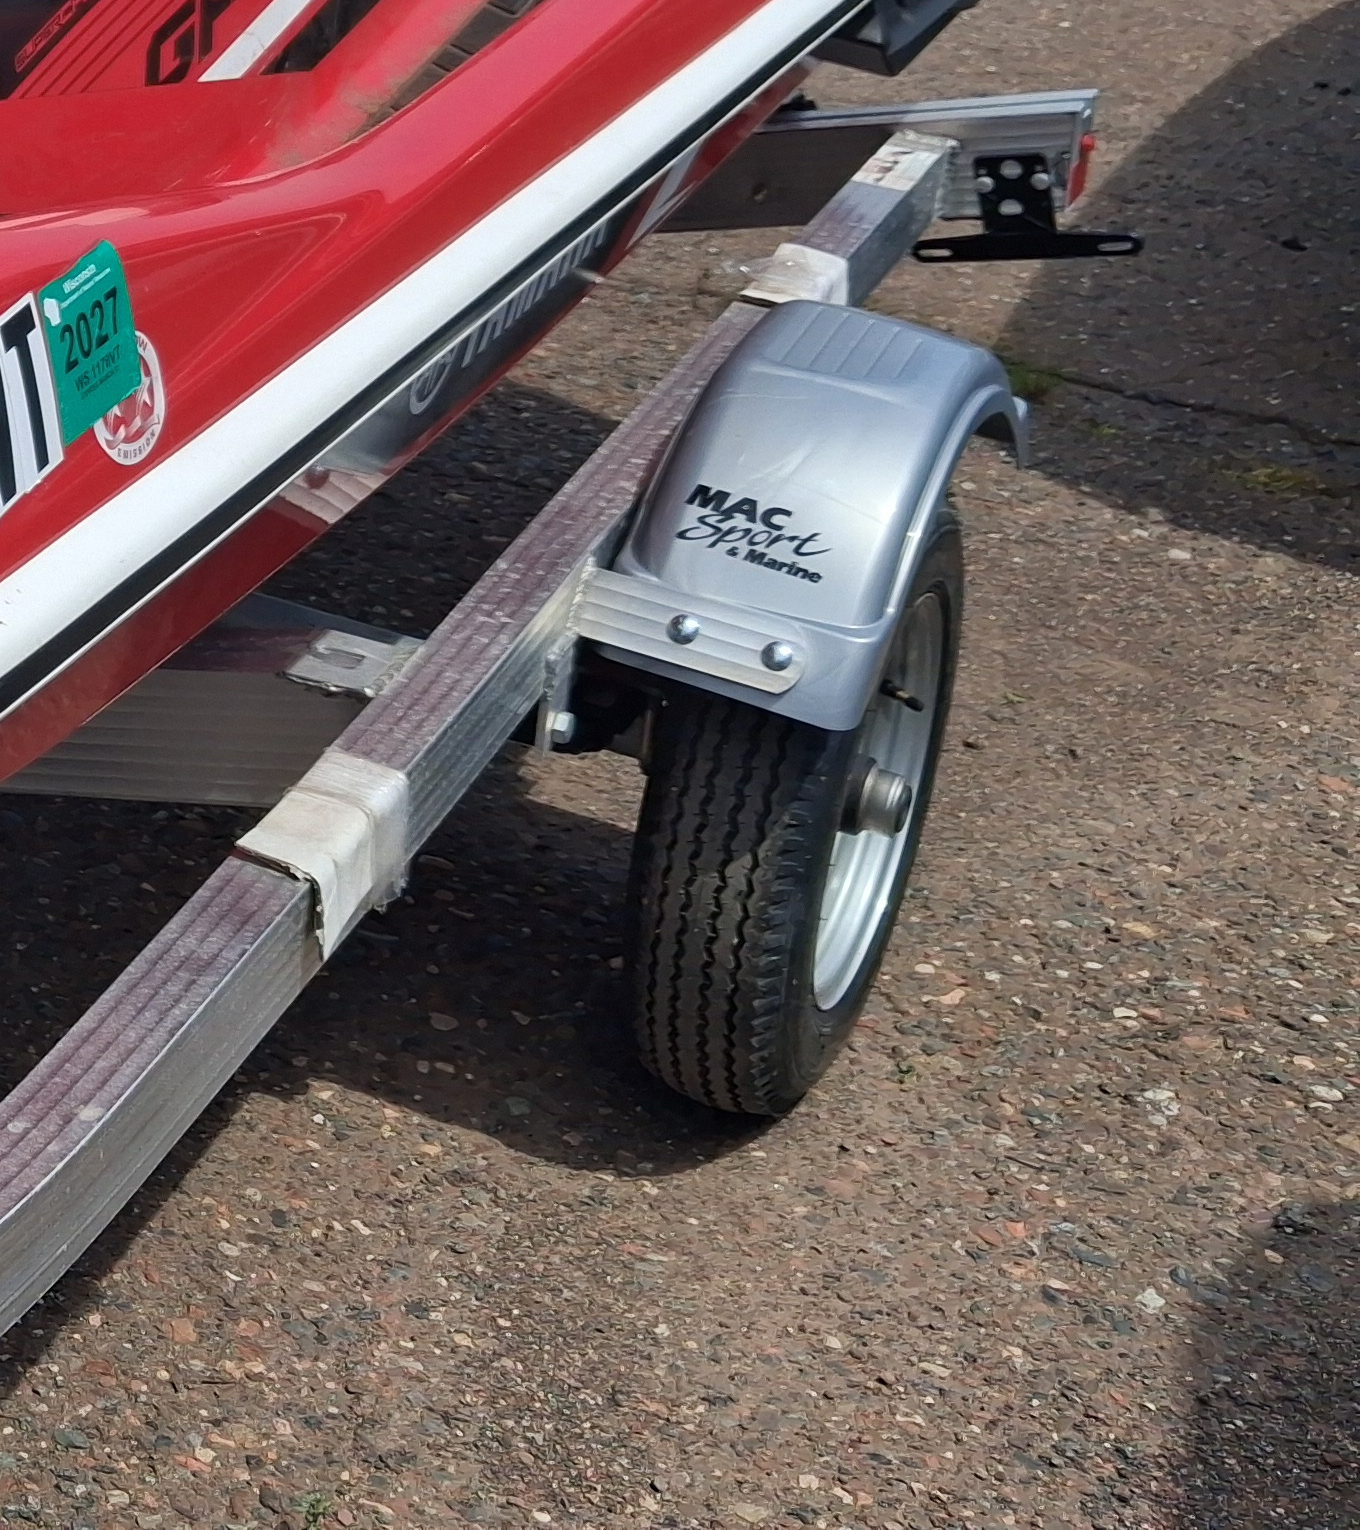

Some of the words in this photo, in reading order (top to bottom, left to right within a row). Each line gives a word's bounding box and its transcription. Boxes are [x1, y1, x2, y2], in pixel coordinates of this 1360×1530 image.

[60, 286, 118, 375] 2027
[684, 484, 792, 530] MAC
[676, 514, 831, 556] Sport
[725, 546, 739, 558] &
[743, 548, 823, 583] Marine
